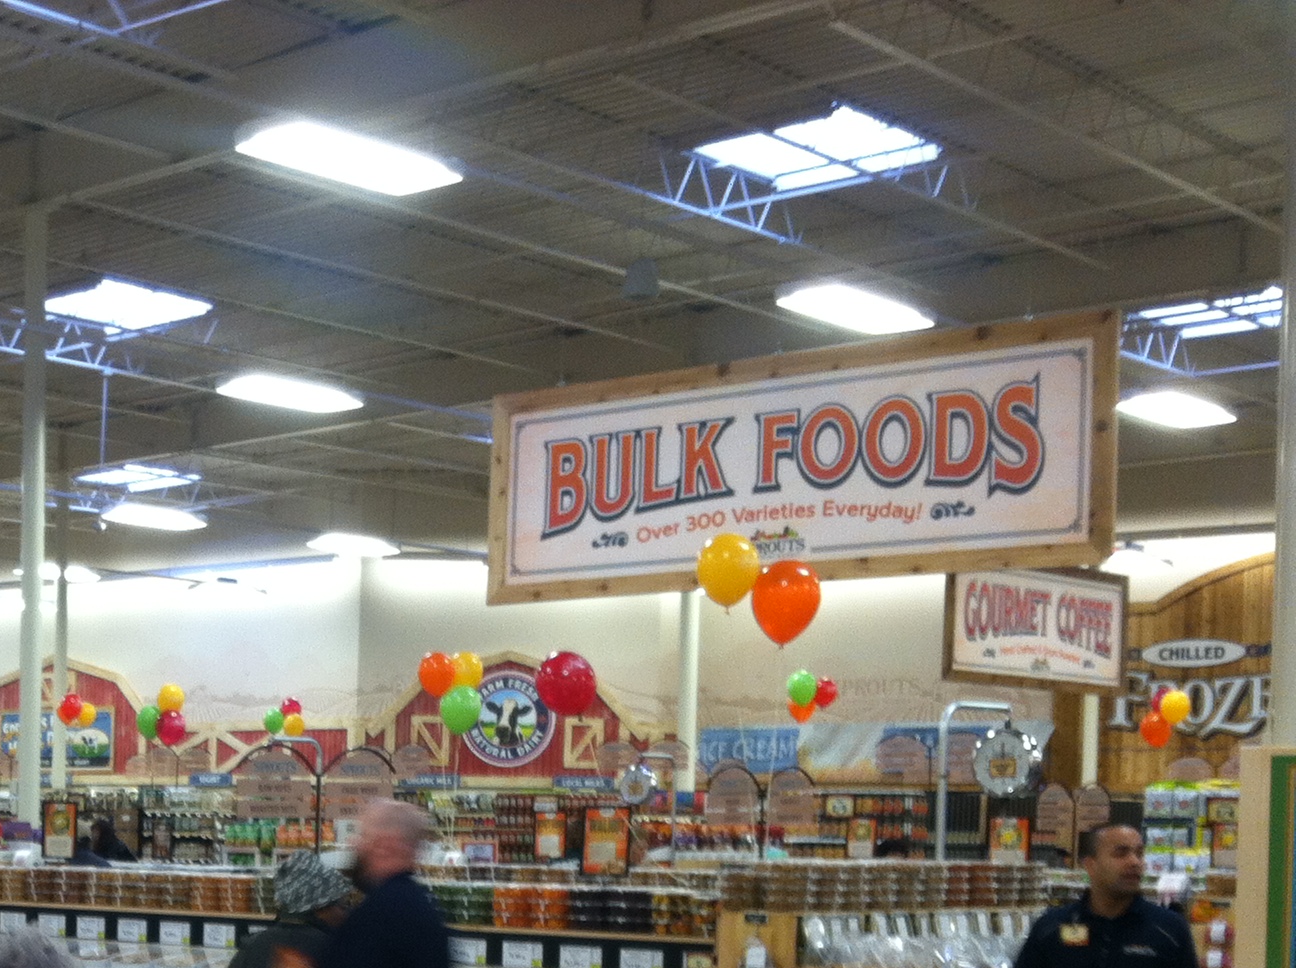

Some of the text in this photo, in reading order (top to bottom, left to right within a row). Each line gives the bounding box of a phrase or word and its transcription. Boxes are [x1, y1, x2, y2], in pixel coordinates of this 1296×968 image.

[541, 373, 1045, 540] BULK FOODS
[636, 499, 922, 545] Over 300 Varieties Everyday!
[964, 580, 1113, 659] GOURMET COFFEE
[1158, 646, 1226, 662] CHILLED
[480, 680, 505, 698] ARM
[841, 678, 922, 697] PROUTS
